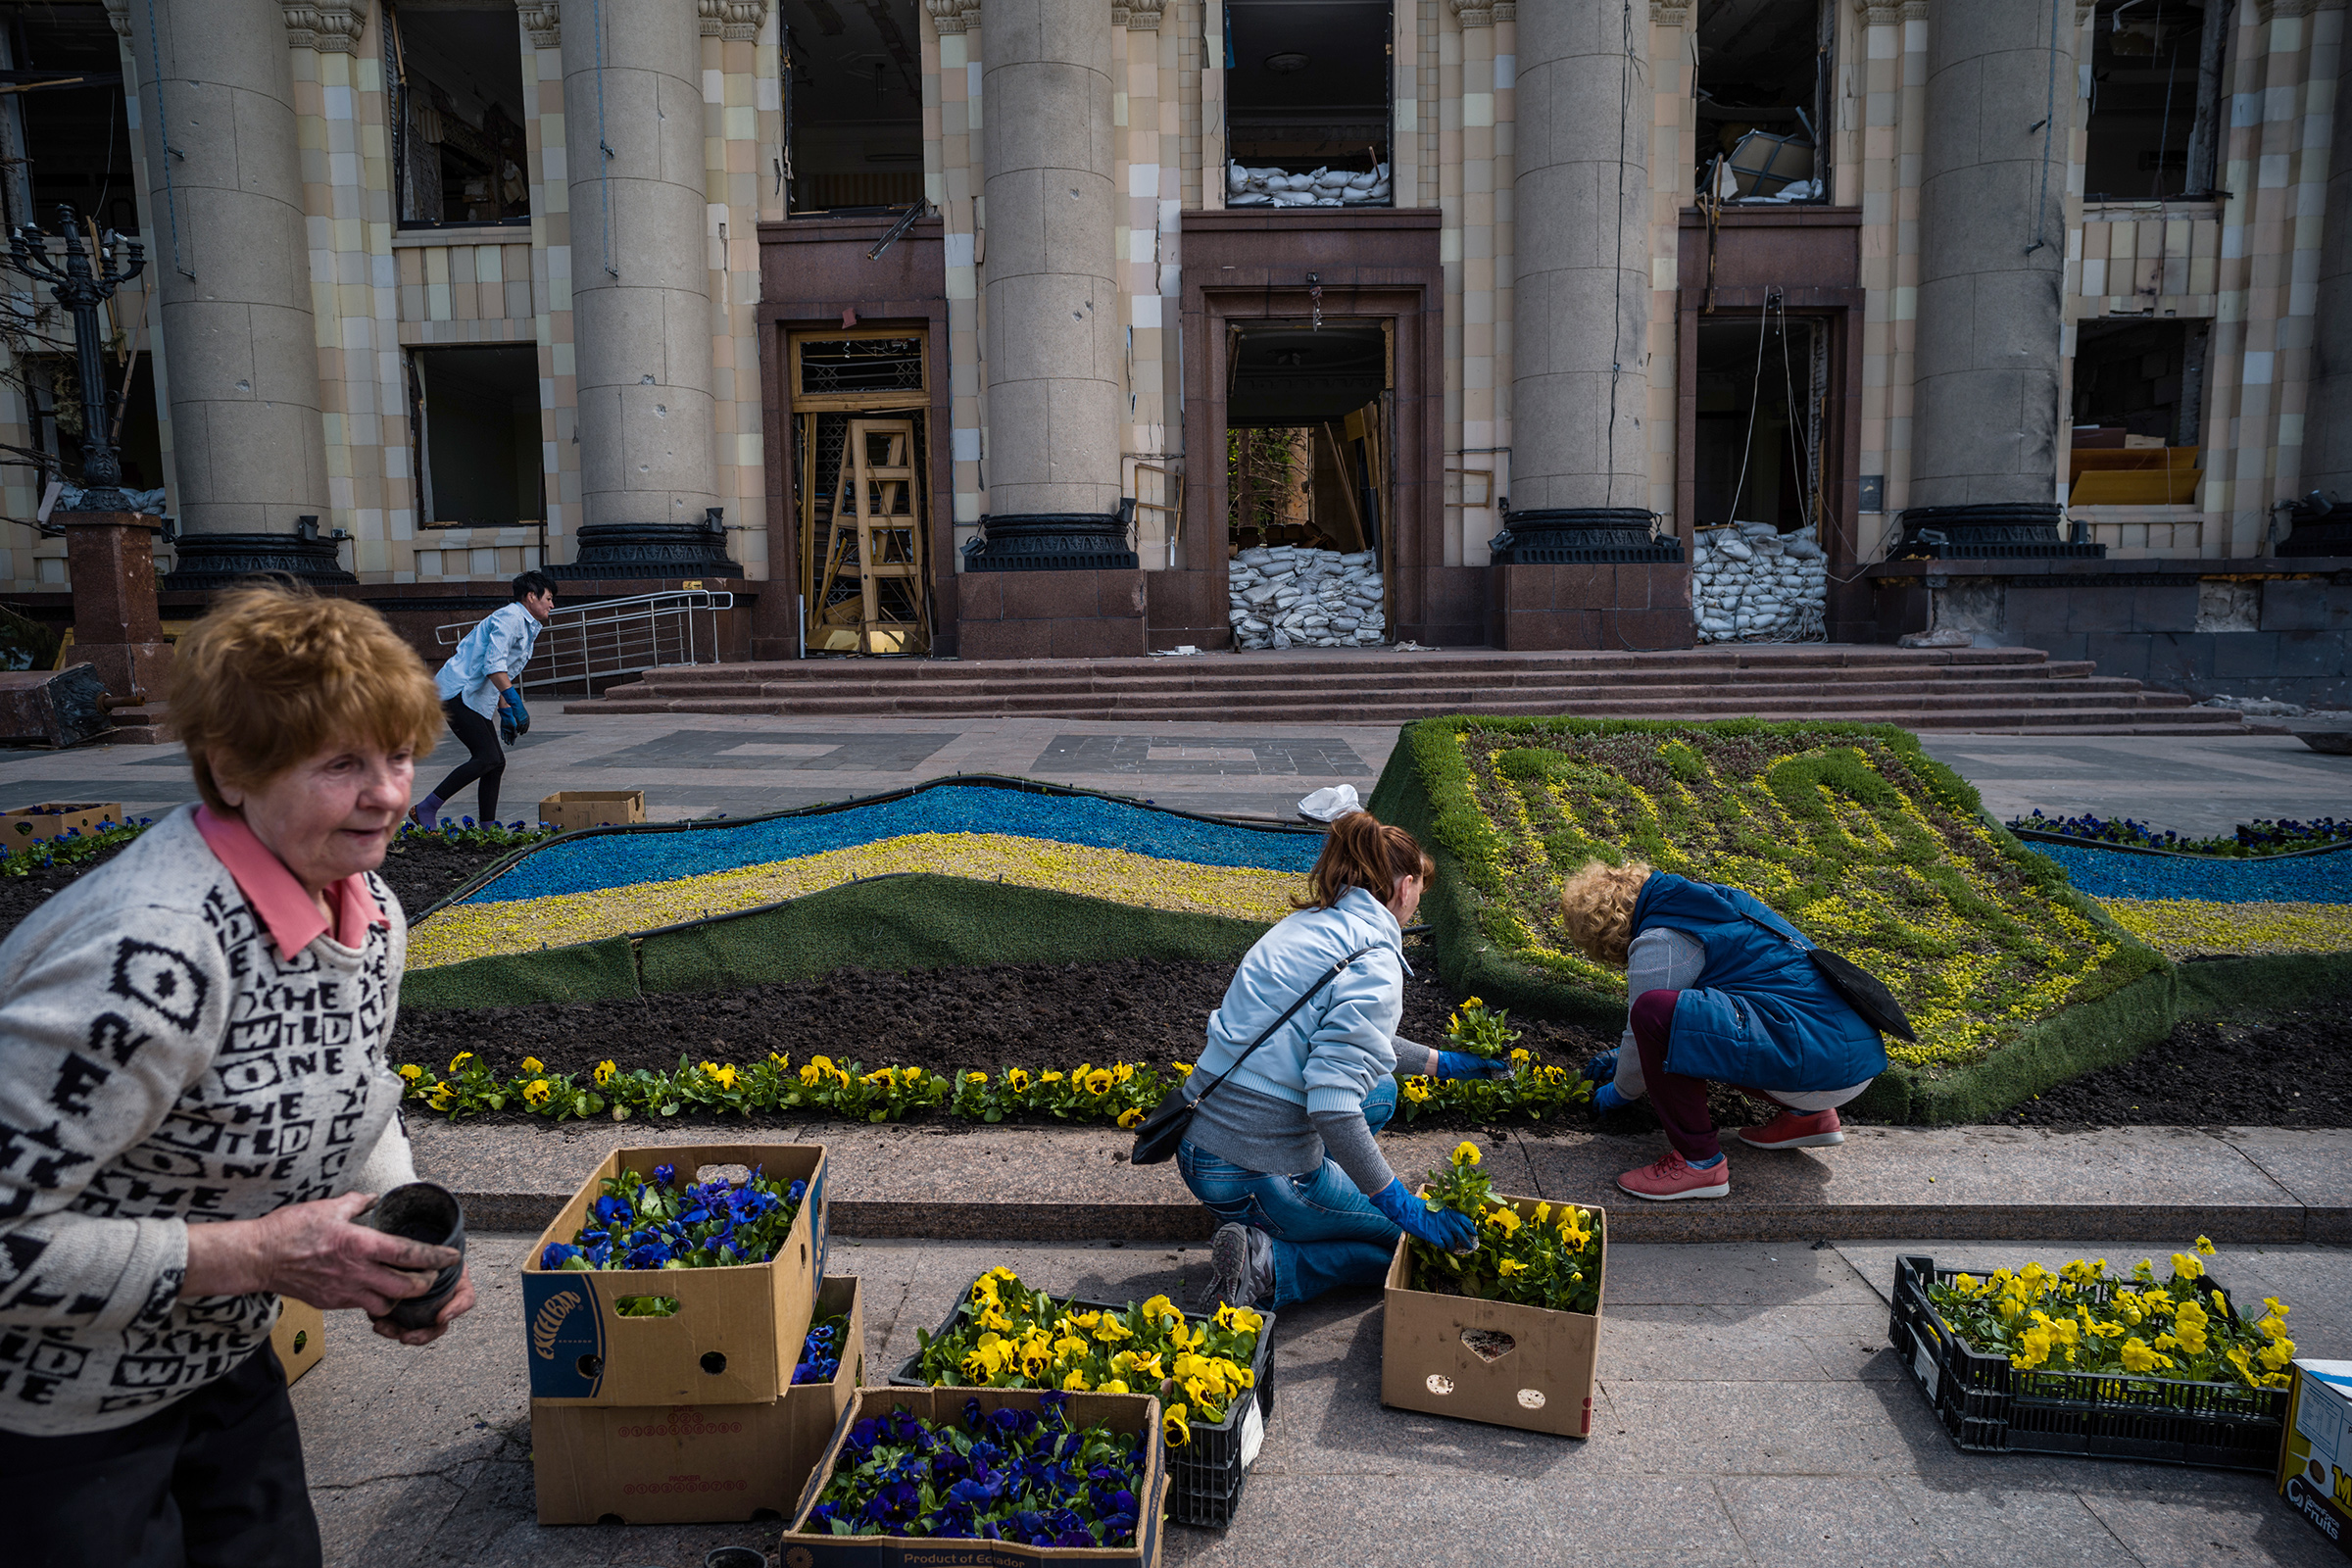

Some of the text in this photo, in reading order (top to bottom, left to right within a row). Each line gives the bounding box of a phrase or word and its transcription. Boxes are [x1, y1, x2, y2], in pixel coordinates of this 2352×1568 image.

[215, 1048, 344, 1097] ONE
[668, 1474, 701, 1483] PACKER
[2303, 1500, 2339, 1541] Fruits
[904, 1553, 1025, 1568] Product of Ecador
